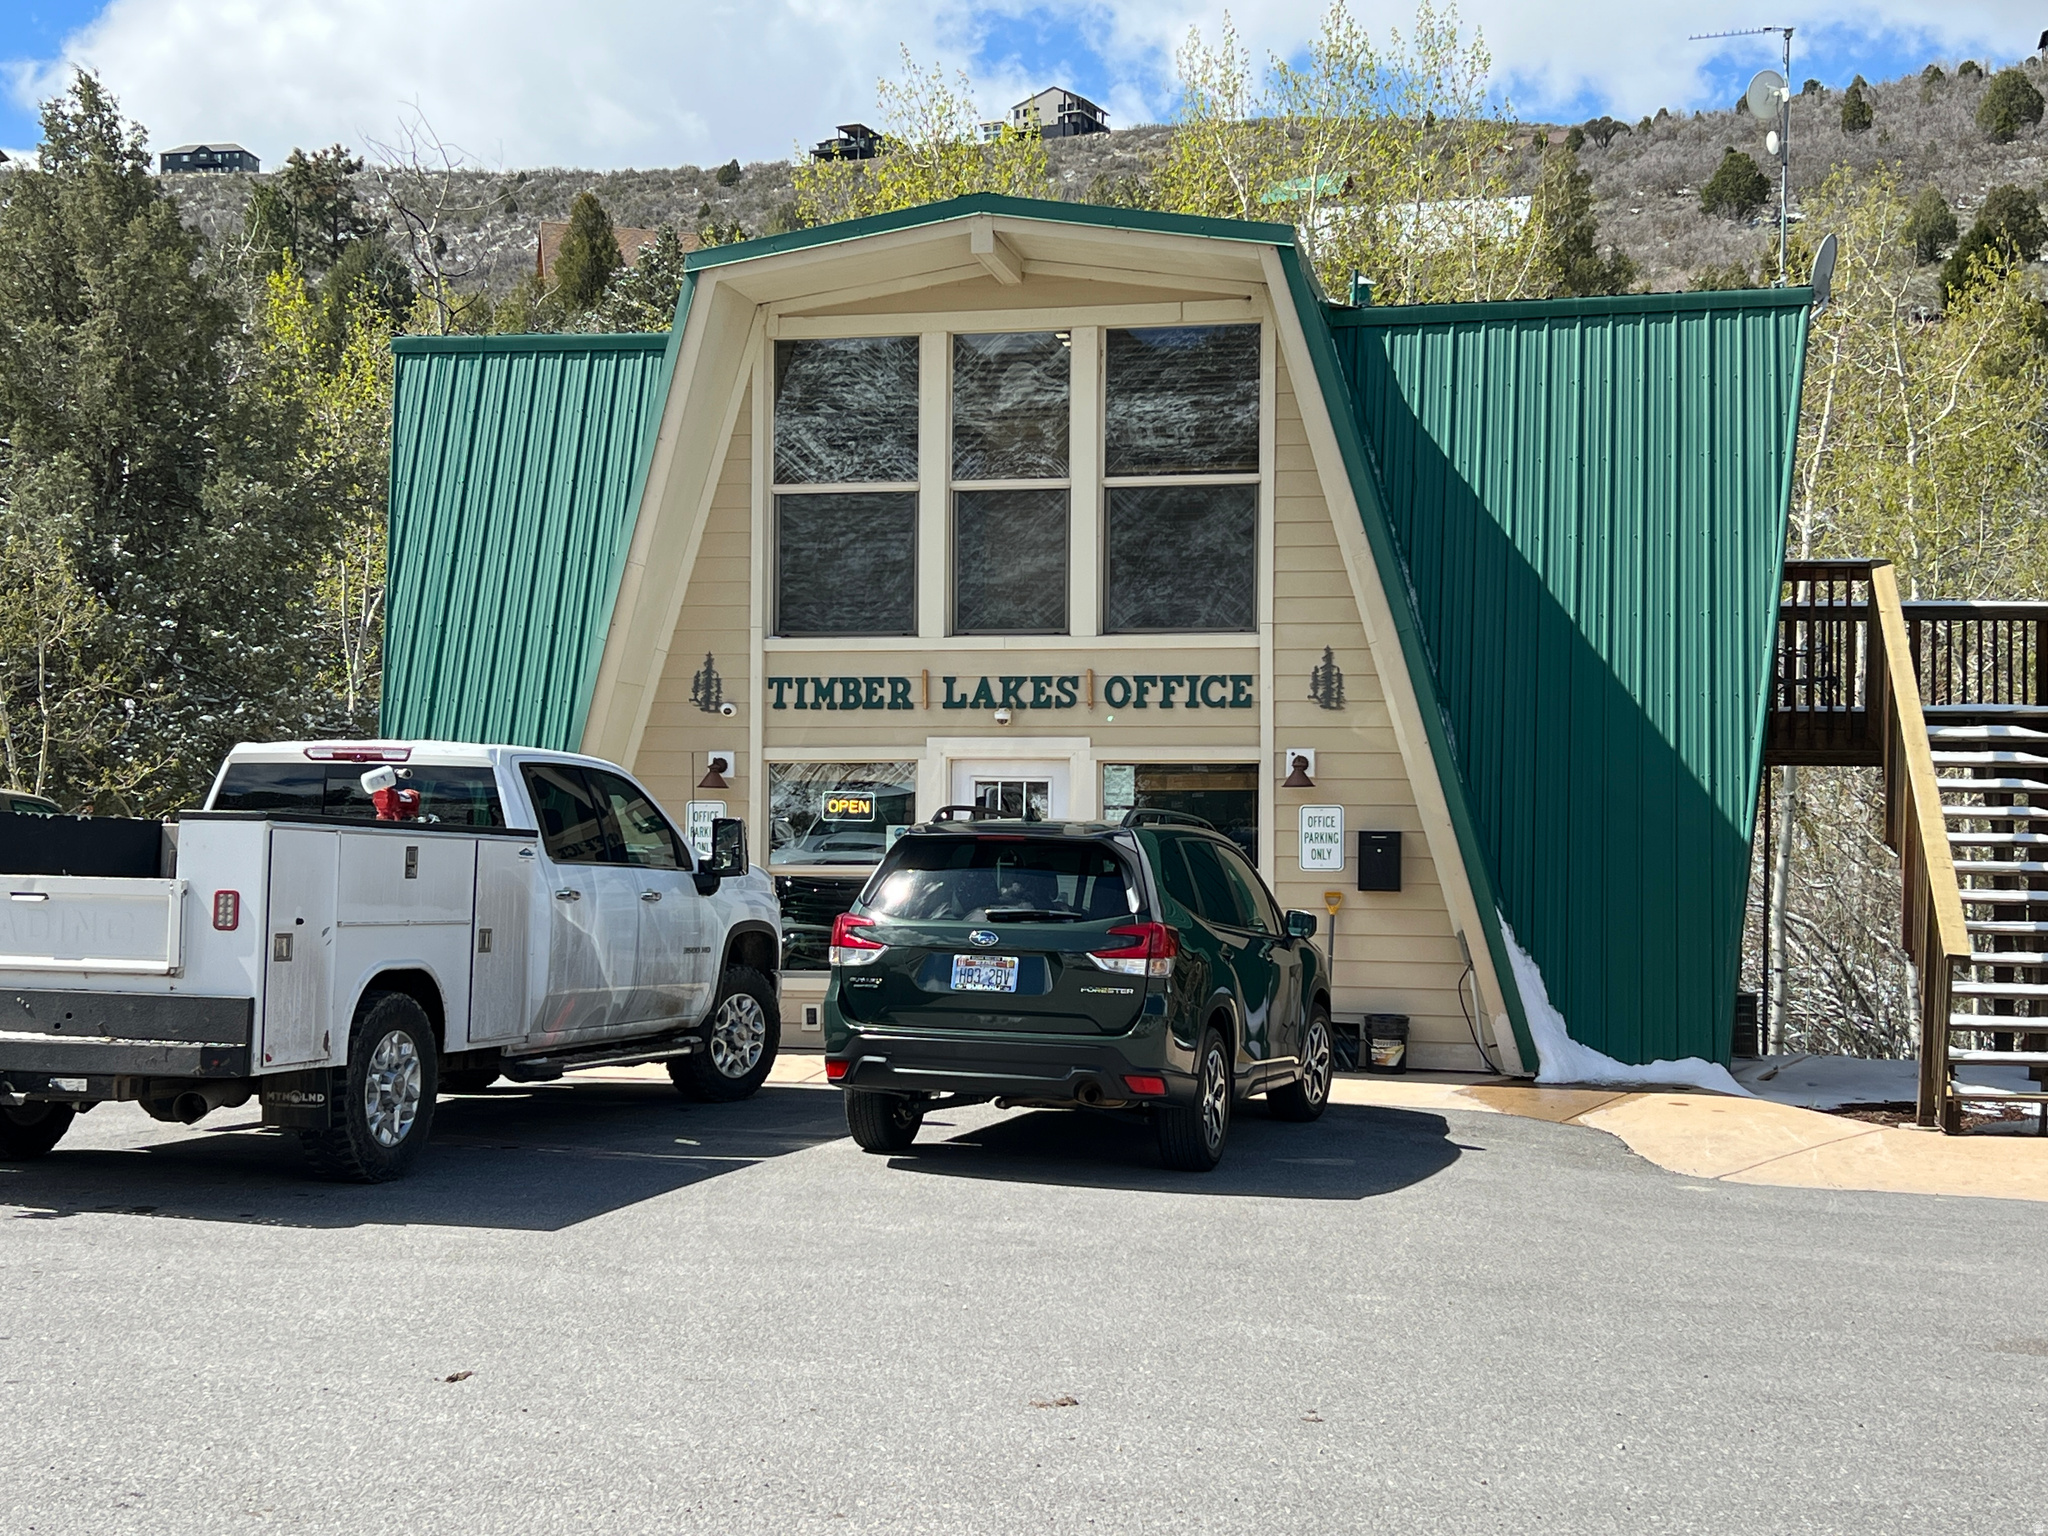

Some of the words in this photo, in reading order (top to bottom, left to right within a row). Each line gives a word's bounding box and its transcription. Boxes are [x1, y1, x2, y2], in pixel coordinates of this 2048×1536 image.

[768, 676, 914, 710] TIMBER
[942, 675, 1080, 709] LAKES
[1104, 675, 1253, 709] OFFICE
[828, 799, 870, 813] OPEN
[693, 811, 719, 822] OFFICE
[1307, 816, 1336, 828] OFFICE
[690, 826, 712, 837] PARKI
[1304, 831, 1339, 844] PARKING
[697, 842, 713, 853] ONL
[1311, 848, 1332, 860] ONLY
[1080, 986, 1134, 994] FORESTER
